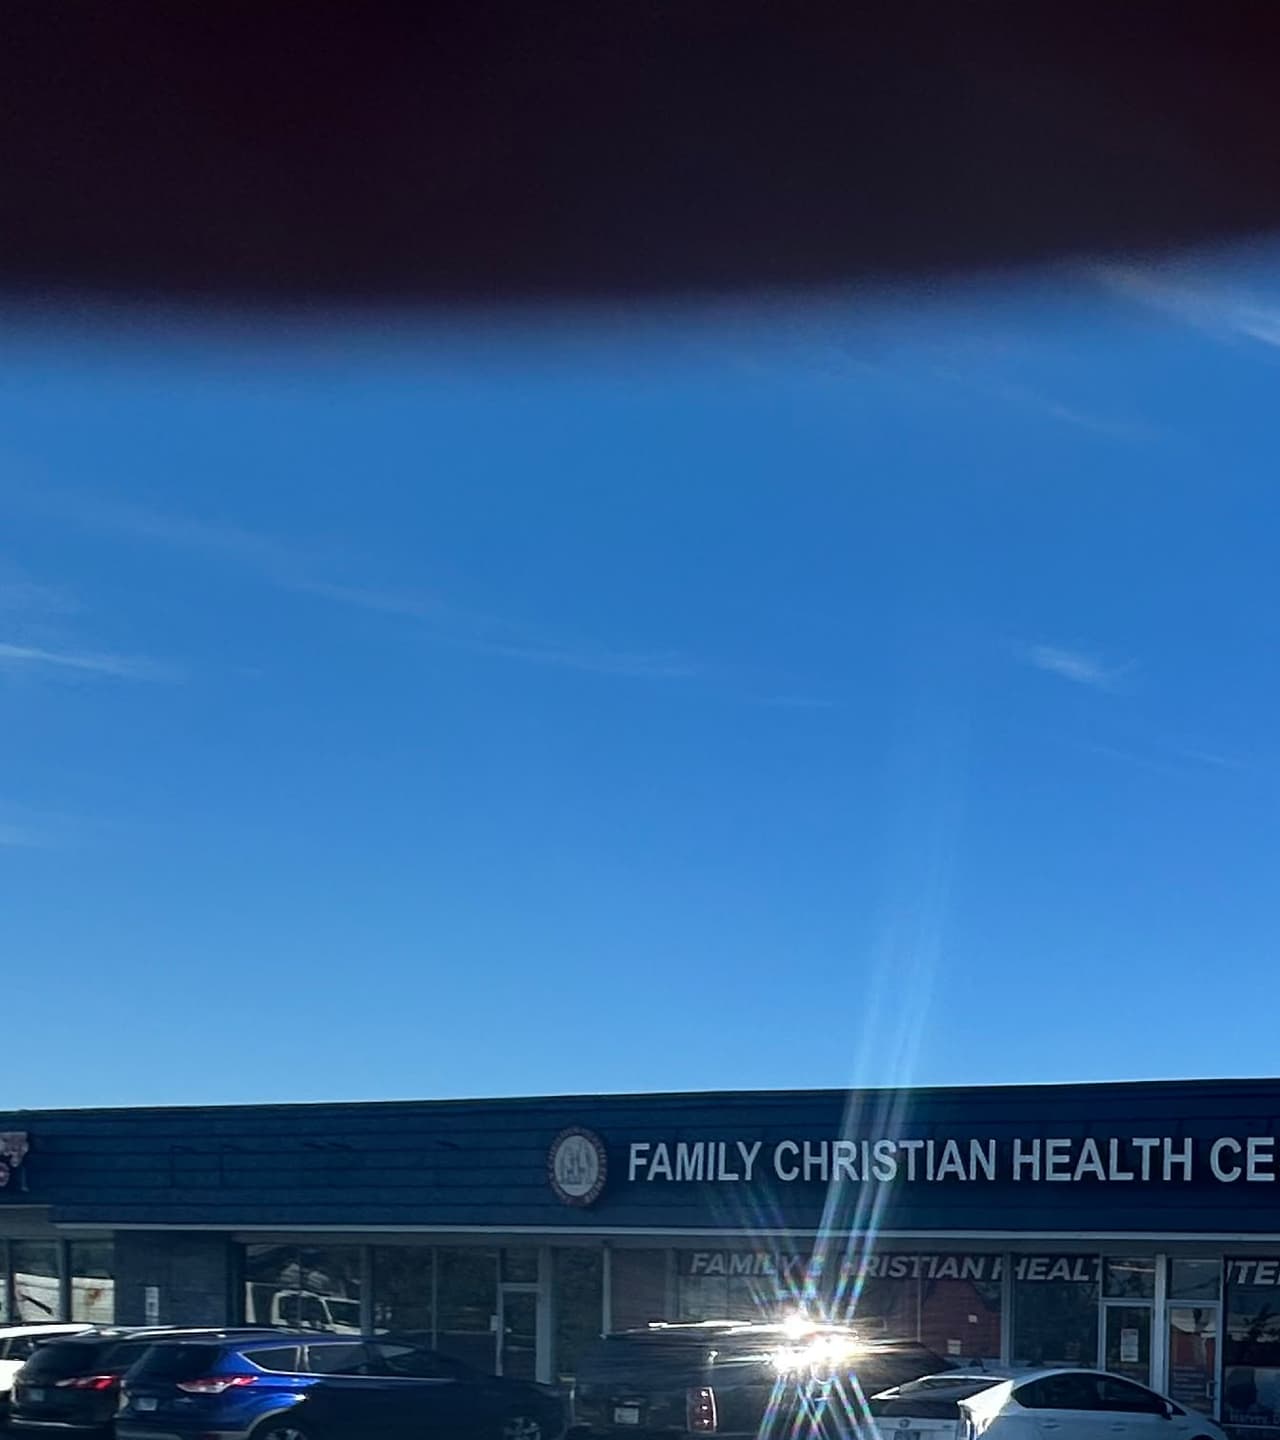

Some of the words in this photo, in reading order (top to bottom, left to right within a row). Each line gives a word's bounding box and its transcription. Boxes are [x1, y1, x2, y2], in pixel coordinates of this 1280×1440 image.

[628, 1141, 762, 1182] FAMILY
[773, 1139, 997, 1182] CHRISTIAN
[1013, 1137, 1192, 1182] HEALTH
